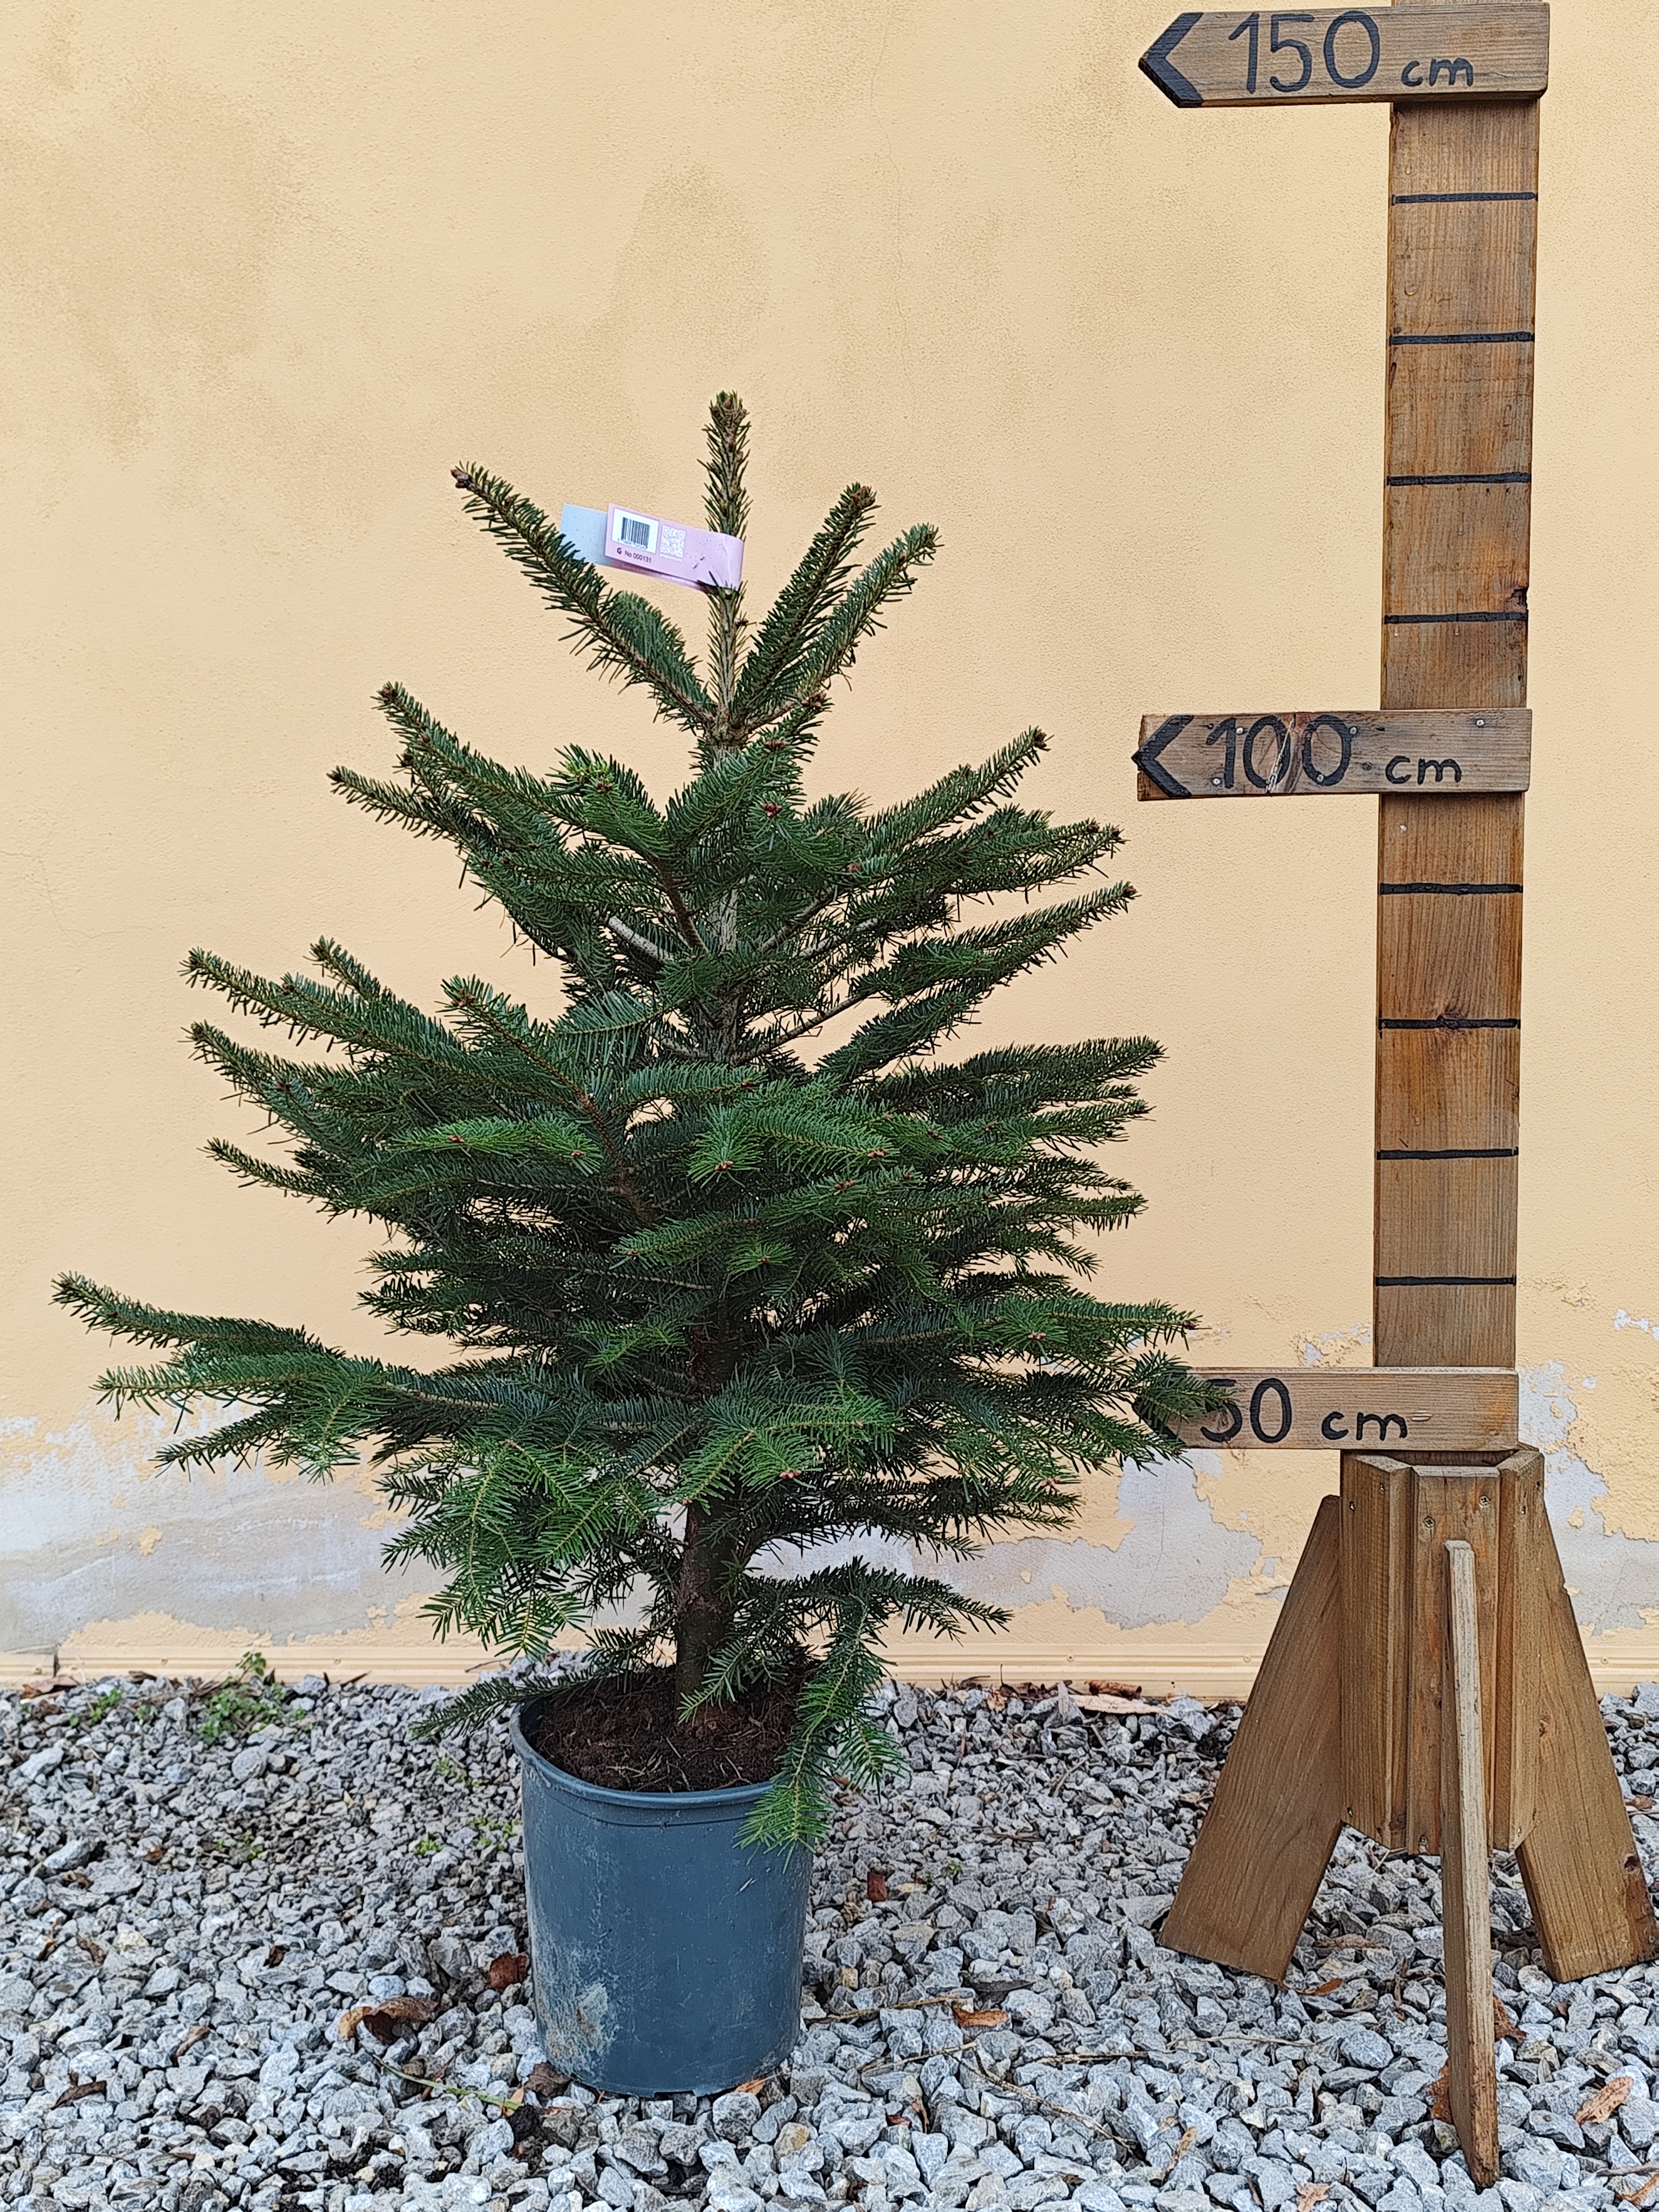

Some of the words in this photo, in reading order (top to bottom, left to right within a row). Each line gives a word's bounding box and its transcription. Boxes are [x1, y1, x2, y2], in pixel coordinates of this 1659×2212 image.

[1228, 9, 1380, 94] 150
[1401, 57, 1474, 87] cm
[633, 553, 652, 563] 000131
[1205, 714, 1353, 789] 100
[1384, 754, 1463, 785] cm
[1200, 1377, 1293, 1444] 50
[1321, 1410, 1409, 1441] cm
